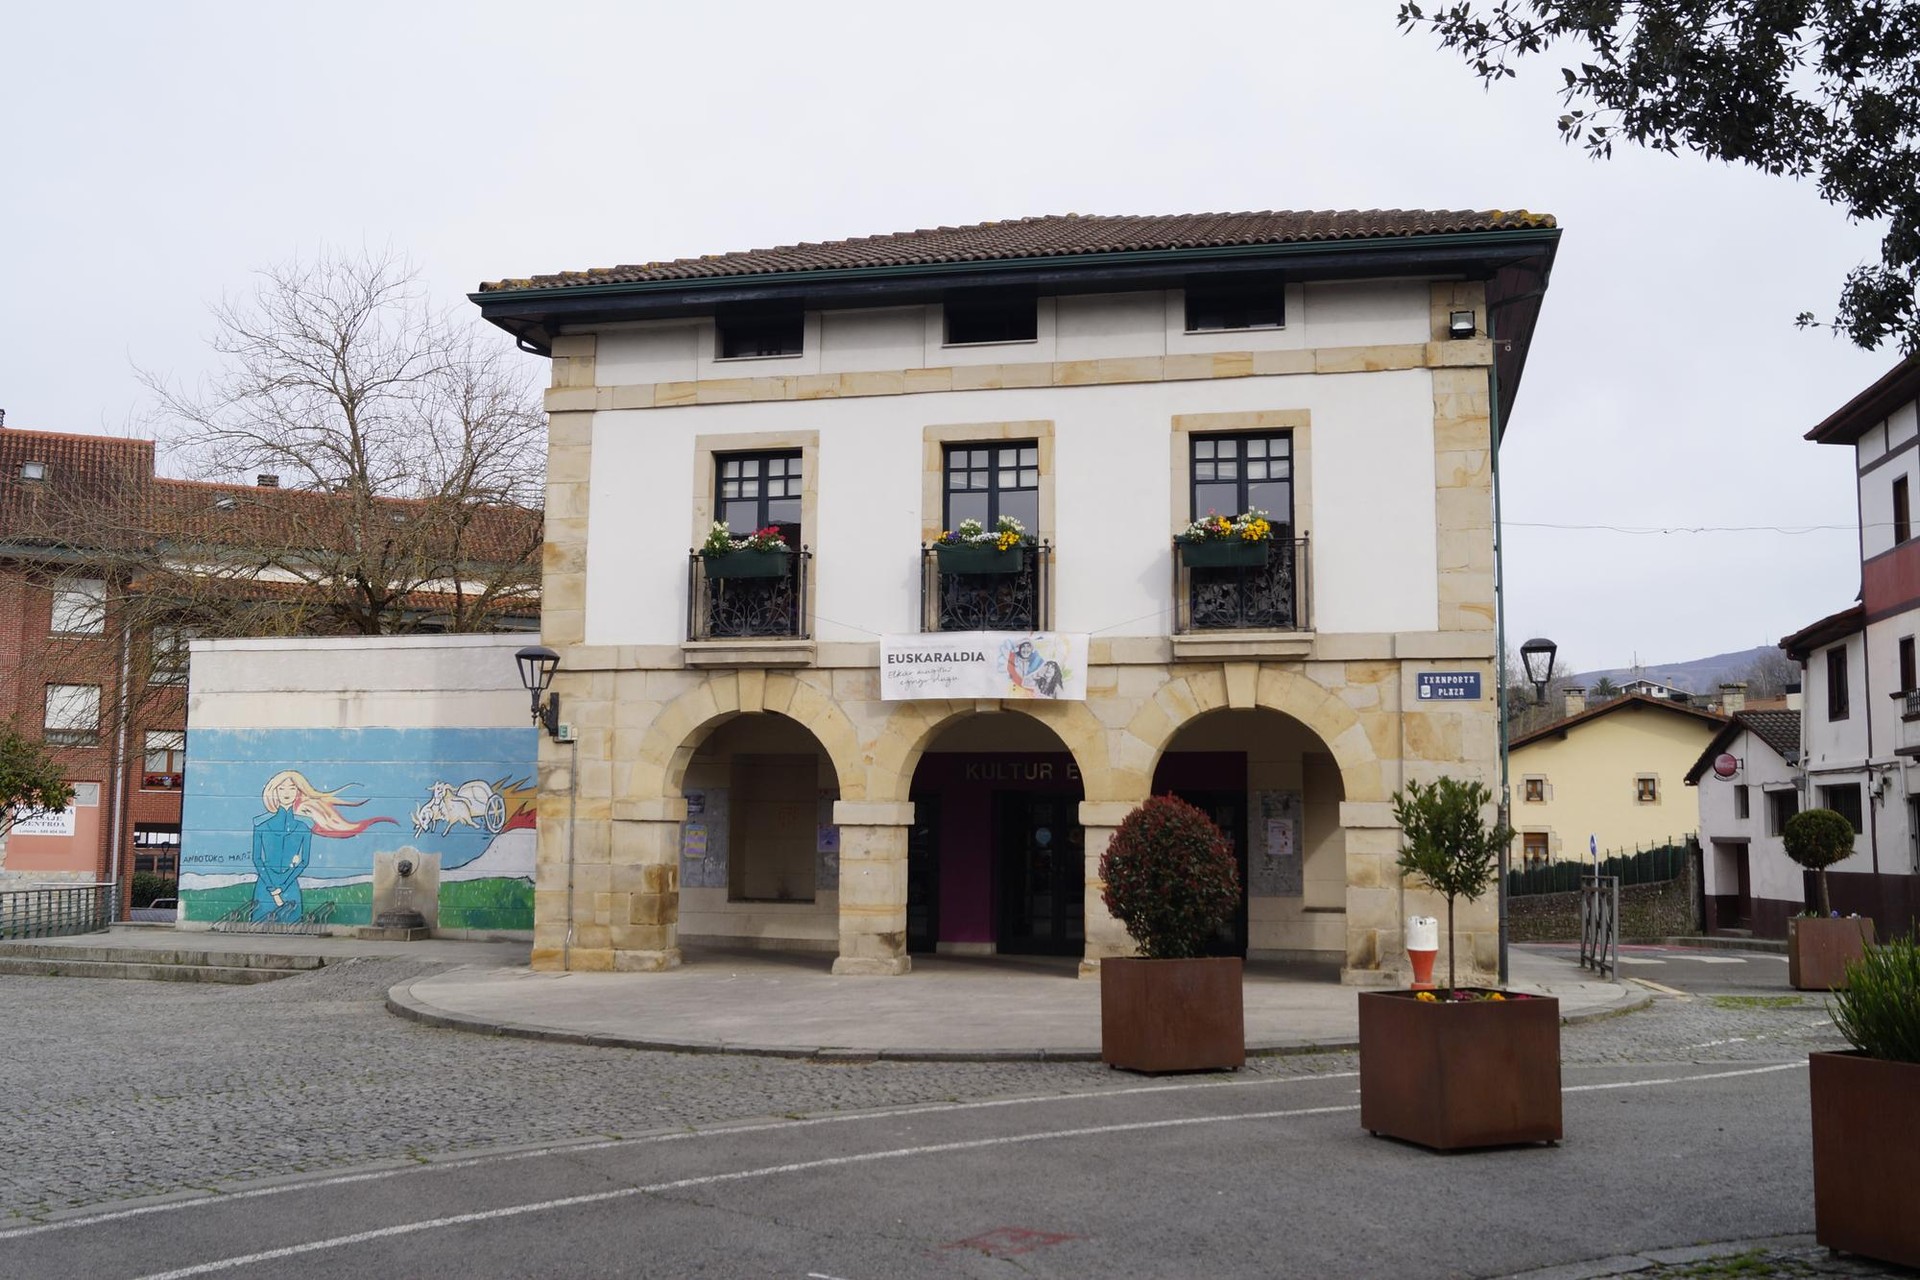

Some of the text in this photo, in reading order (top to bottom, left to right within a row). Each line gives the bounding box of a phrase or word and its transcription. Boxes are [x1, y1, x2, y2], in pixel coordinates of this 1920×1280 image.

[887, 651, 985, 664] EUSKARALDIA
[1423, 676, 1475, 684] TXANPORTA
[1438, 688, 1465, 696] PLAZA
[966, 763, 1053, 780] KULTUR
